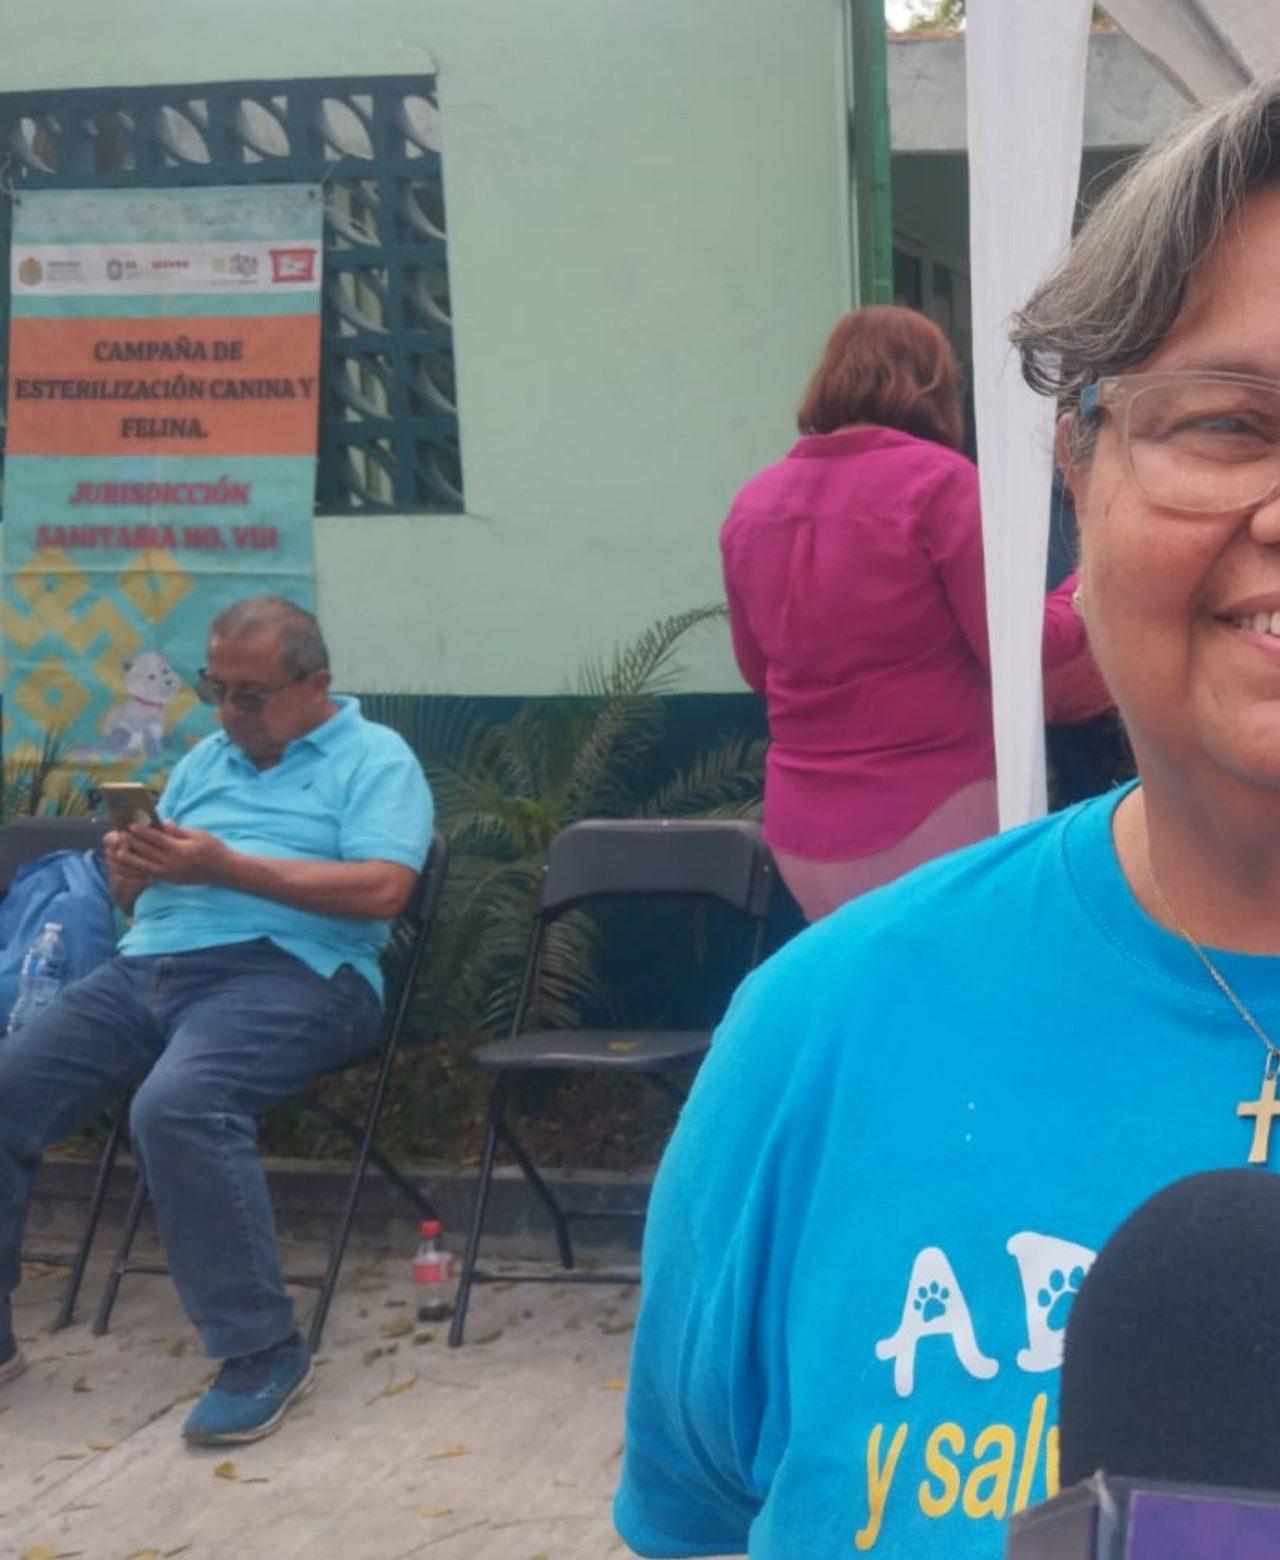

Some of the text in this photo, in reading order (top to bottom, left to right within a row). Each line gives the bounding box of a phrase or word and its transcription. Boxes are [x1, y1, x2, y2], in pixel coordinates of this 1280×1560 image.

[94, 337, 244, 362] CAMPAÑA DE
[15, 375, 314, 399] ESTERILIZACIÓN CANINA Y
[120, 418, 209, 439] FELINA.
[69, 476, 250, 505] JURISDICCIÓN
[36, 524, 179, 550] SANITARIA
[854, 1421, 908, 1550] y
